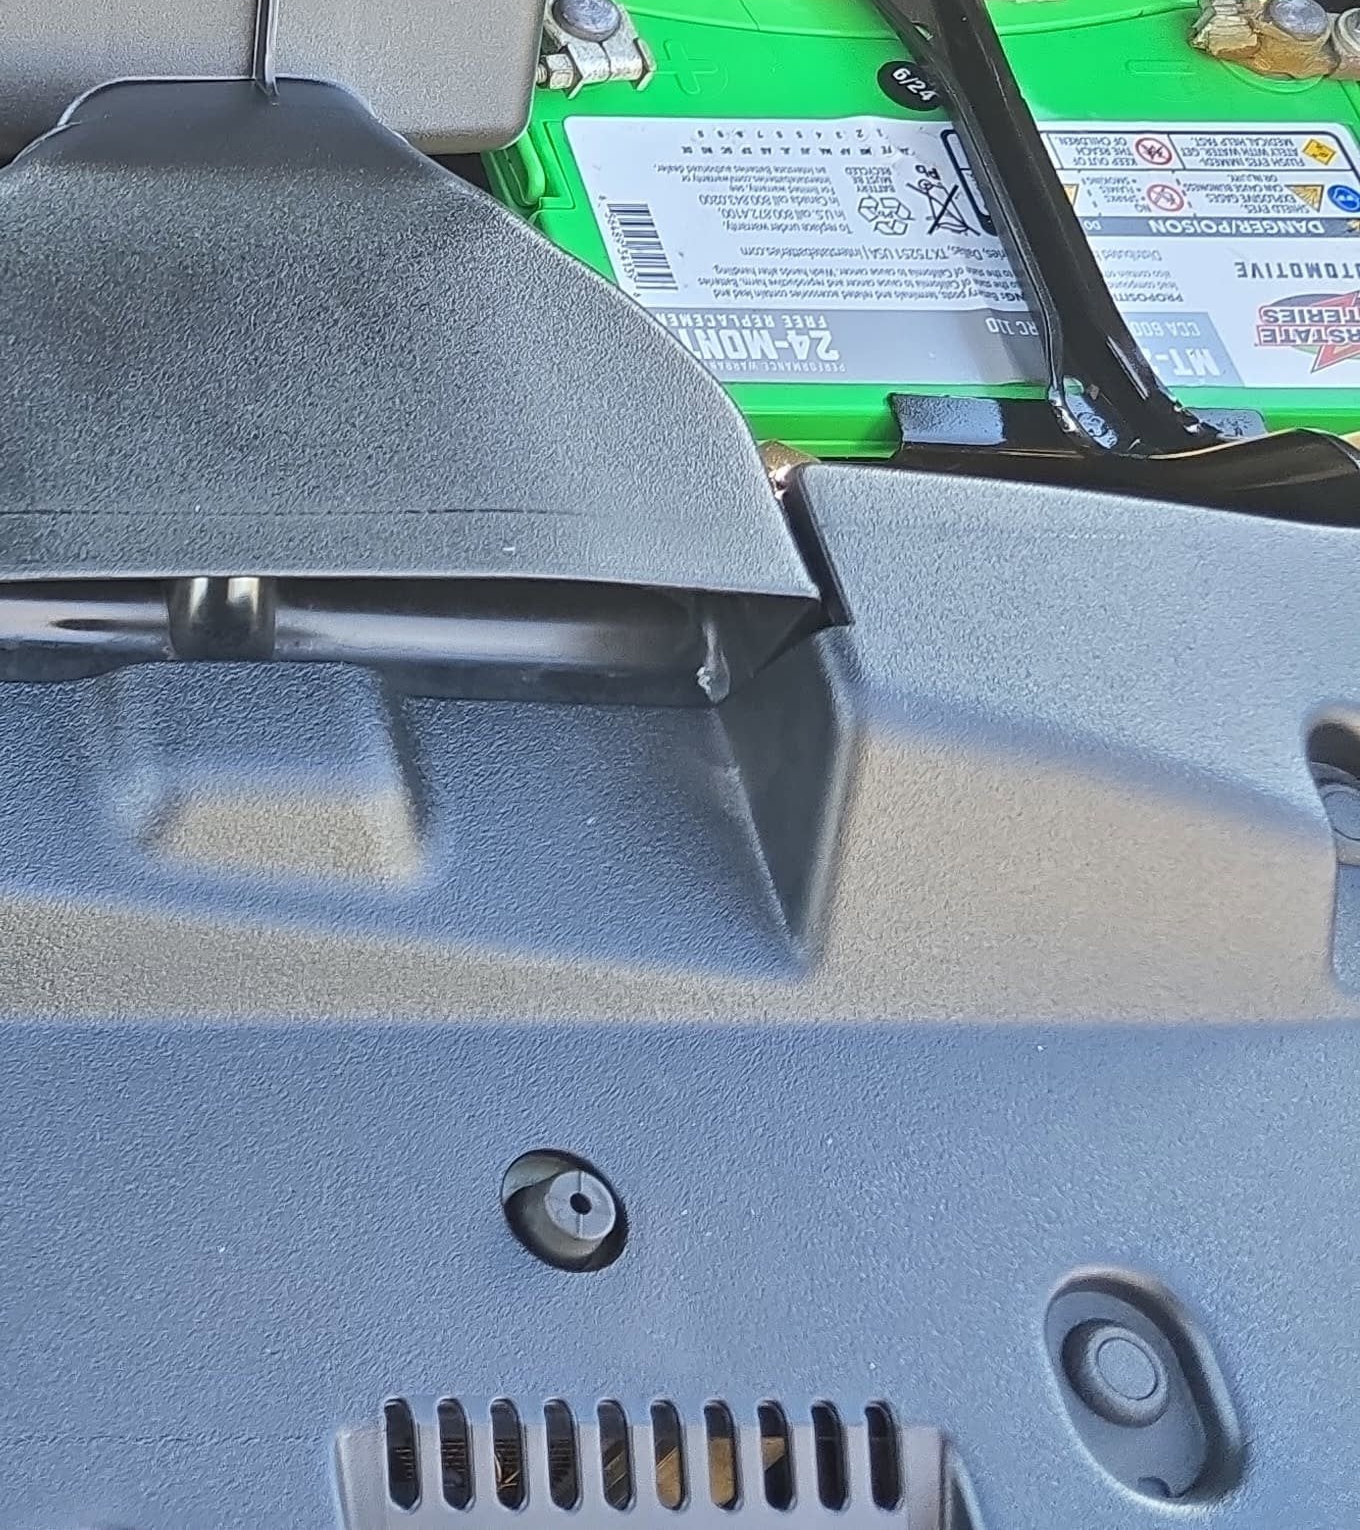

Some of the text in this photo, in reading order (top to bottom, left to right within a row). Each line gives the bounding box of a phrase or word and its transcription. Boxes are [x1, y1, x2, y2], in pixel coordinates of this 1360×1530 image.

[891, 67, 938, 102] 6/24
[1113, 137, 1128, 147] OF
[1219, 137, 1247, 147] HELP
[1247, 136, 1295, 147] MEDICAL
[1075, 147, 1133, 157] THE REACH
[1180, 146, 1200, 157] GET
[1241, 147, 1268, 157] WITH
[1269, 147, 1299, 157] ATELY
[1072, 157, 1138, 167] KEEP OUT OF
[1245, 157, 1269, 168] EYES
[1270, 157, 1306, 168] FLUSH
[844, 166, 893, 176] RECYCLED
[914, 164, 941, 181] Pb
[852, 175, 893, 185] MUST BE
[856, 184, 896, 194] BATTERY
[1235, 184, 1263, 193] CAUSE
[1263, 184, 1285, 193] CAN
[772, 196, 790, 207] call
[791, 196, 828, 208] Canada
[1238, 194, 1298, 204] EXPLOSIVE
[1135, 204, 1152, 213] NO
[1271, 204, 1311, 214] SHIELD
[794, 209, 812, 221] call
[771, 224, 800, 234] under
[802, 222, 837, 234] replace
[838, 224, 853, 235] To
[1083, 219, 1325, 236] DANGER/POISON DO
[867, 247, 894, 261] USA
[908, 268, 953, 279] California
[915, 279, 960, 291] California
[781, 314, 829, 330] FREE
[985, 317, 1040, 336] RC 110
[1165, 319, 1201, 338] CCA
[763, 361, 848, 374] PERFORMANCE
